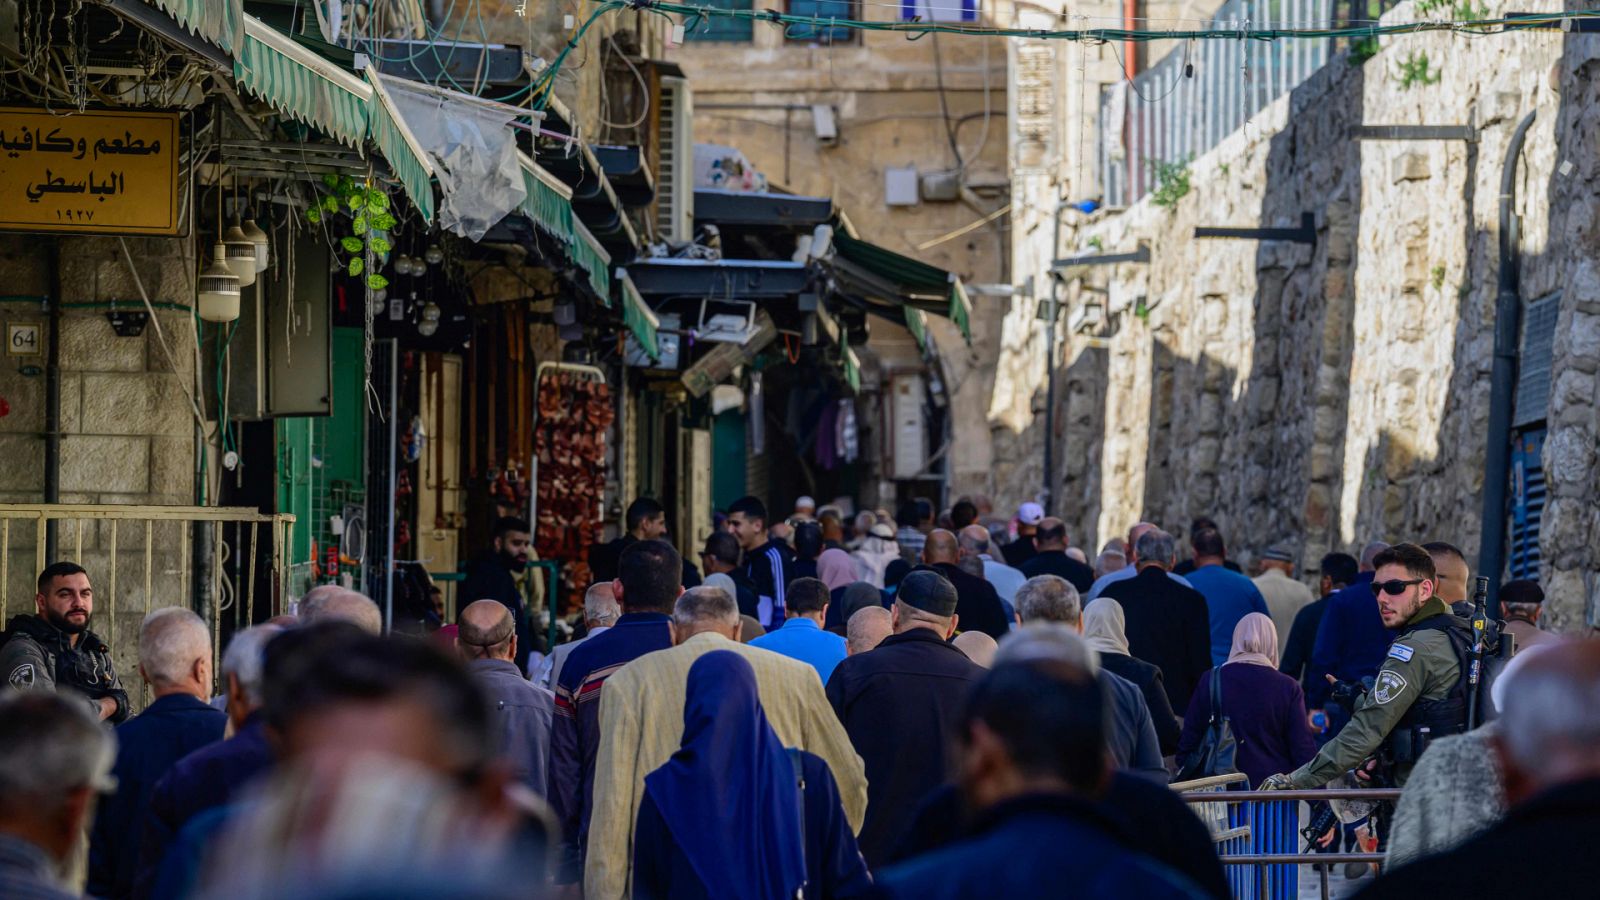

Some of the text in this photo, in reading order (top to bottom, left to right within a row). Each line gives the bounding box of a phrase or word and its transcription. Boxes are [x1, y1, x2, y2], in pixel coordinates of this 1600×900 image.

[94, 130, 161, 161] مطعم
[26, 168, 124, 203] الباسطي
[56, 209, 95, 221] ١٩٢٧
[12, 330, 37, 348] 64
